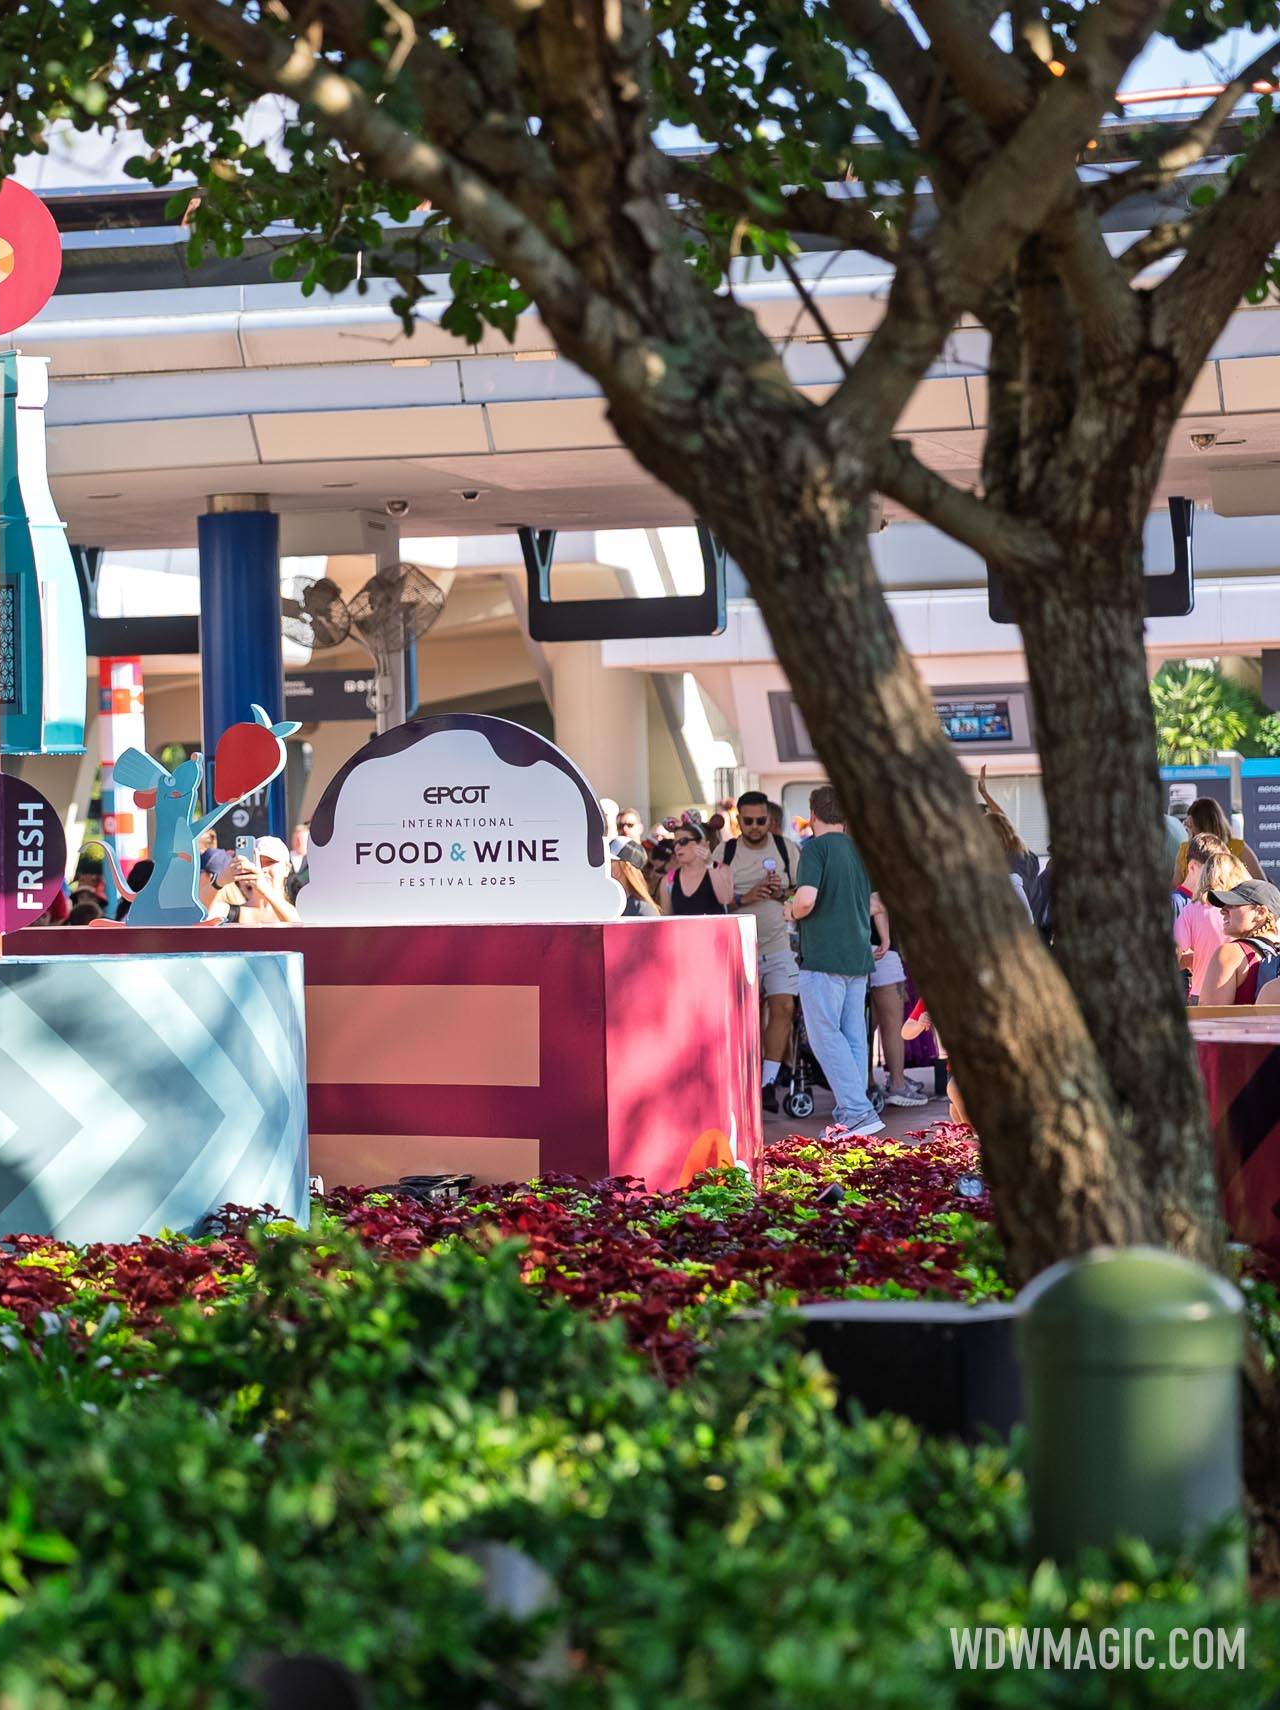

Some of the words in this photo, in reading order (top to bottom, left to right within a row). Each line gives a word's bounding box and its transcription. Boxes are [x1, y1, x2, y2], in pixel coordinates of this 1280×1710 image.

[423, 785, 490, 805] EPCOT
[402, 817, 514, 829] INTERNATIONAL
[17, 802, 44, 910] FRESH
[355, 841, 443, 865] FOOD
[449, 842, 467, 862] &
[473, 839, 560, 863] WINE
[399, 877, 473, 887] FESTIVAL
[480, 876, 516, 886] 2025
